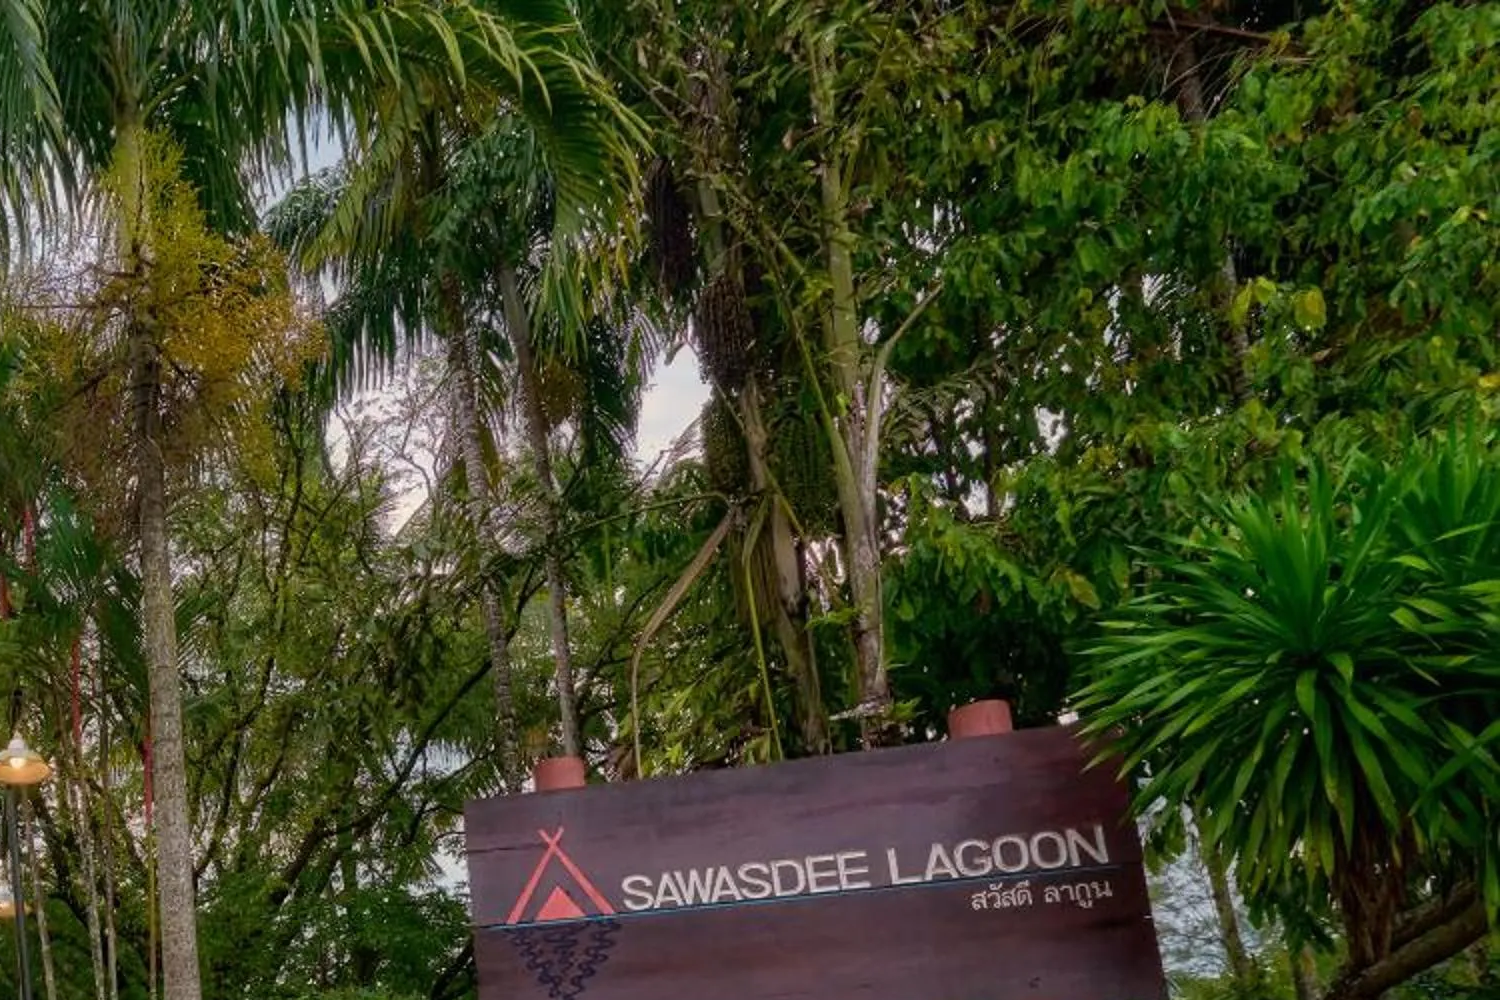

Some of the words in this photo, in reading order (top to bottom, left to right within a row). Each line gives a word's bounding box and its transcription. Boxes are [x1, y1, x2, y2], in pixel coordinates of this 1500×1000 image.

[621, 850, 871, 911] SAWASDEE
[886, 824, 1110, 885] LAGOON
[971, 880, 1033, 910] สวัสดี
[1043, 880, 1113, 909] ลากูน
